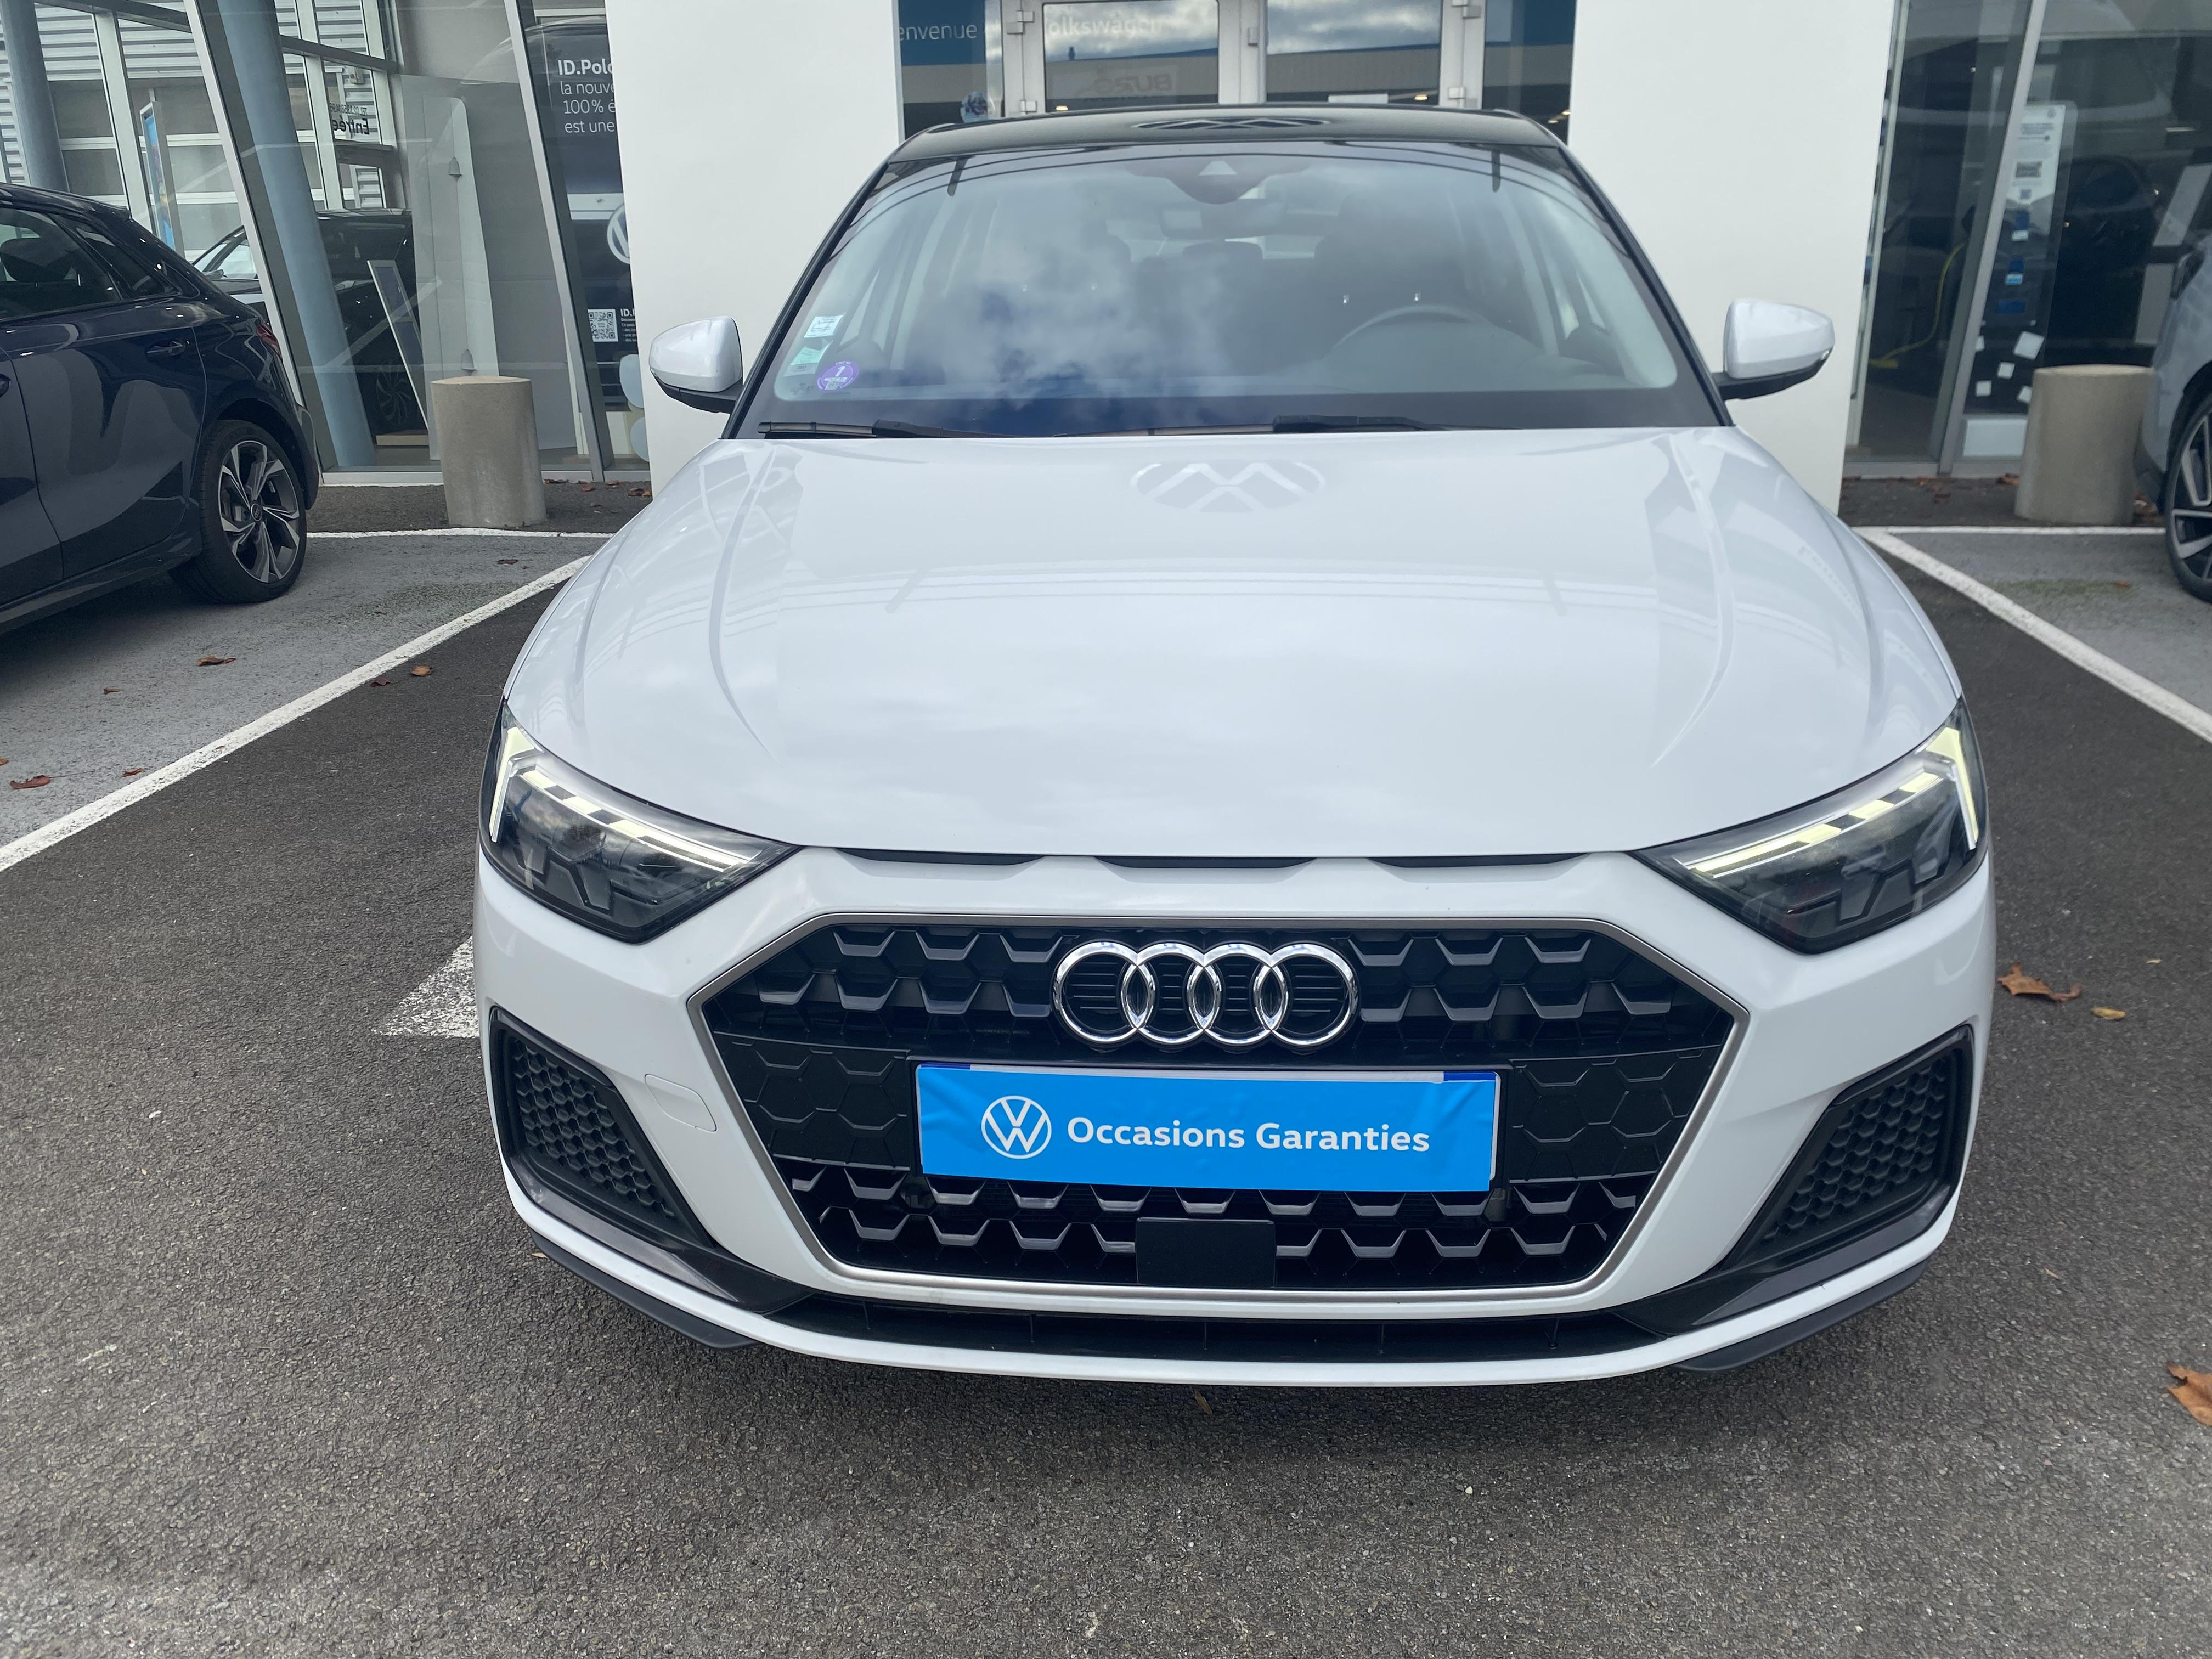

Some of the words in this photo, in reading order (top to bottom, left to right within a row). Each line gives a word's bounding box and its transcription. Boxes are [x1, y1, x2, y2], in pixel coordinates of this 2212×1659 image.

[900, 24, 978, 41] envenue
[560, 81, 572, 94] la
[563, 99, 603, 114] 100%
[565, 121, 585, 133] est
[589, 121, 615, 132] une
[834, 366, 846, 377] 1
[1067, 1116, 1245, 1148] Occasions
[1256, 1122, 1430, 1152] Garanties
